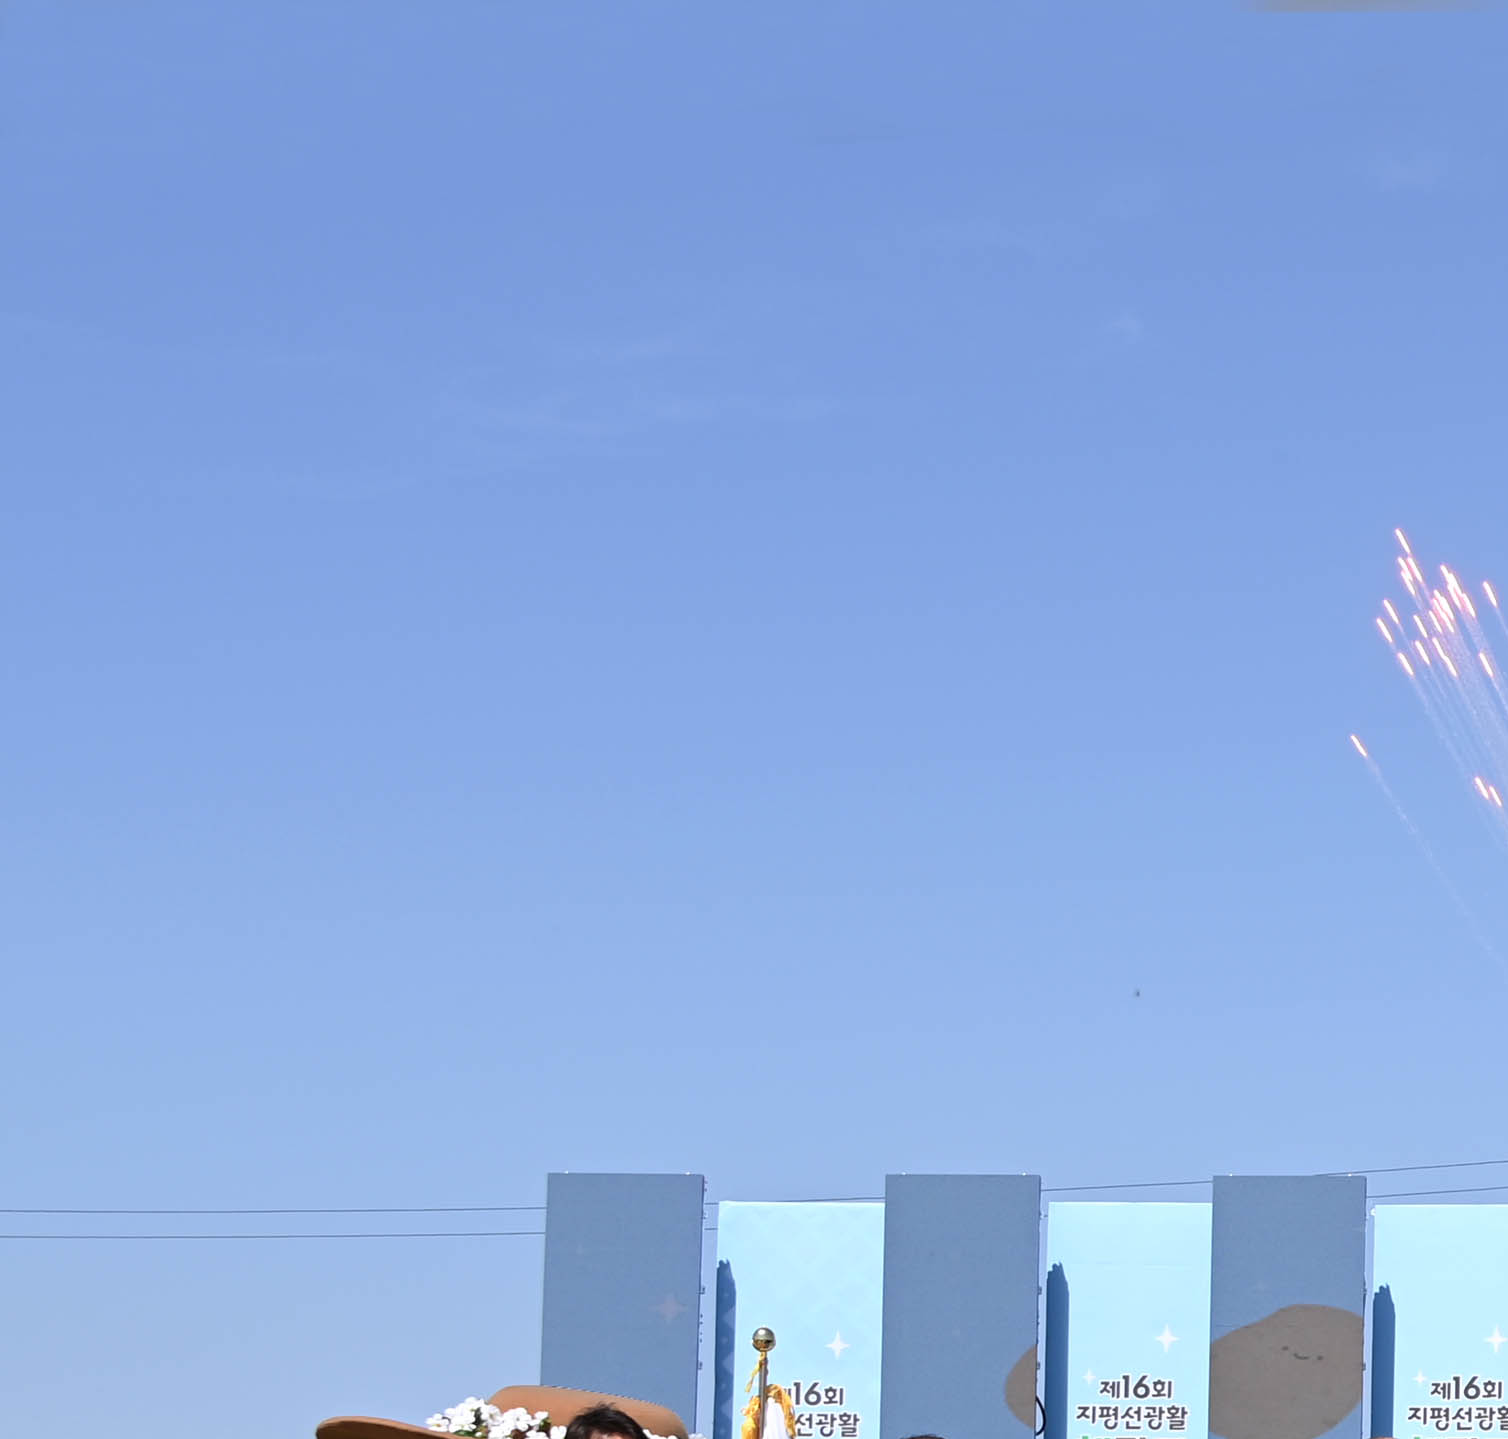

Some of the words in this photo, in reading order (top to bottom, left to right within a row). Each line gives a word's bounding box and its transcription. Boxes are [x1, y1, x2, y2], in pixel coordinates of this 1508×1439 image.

[785, 1382, 844, 1406] 16회
[1100, 1375, 1172, 1399] 제16회
[1431, 1376, 1502, 1400] 제16회
[1076, 1405, 1188, 1431] 지평선광활
